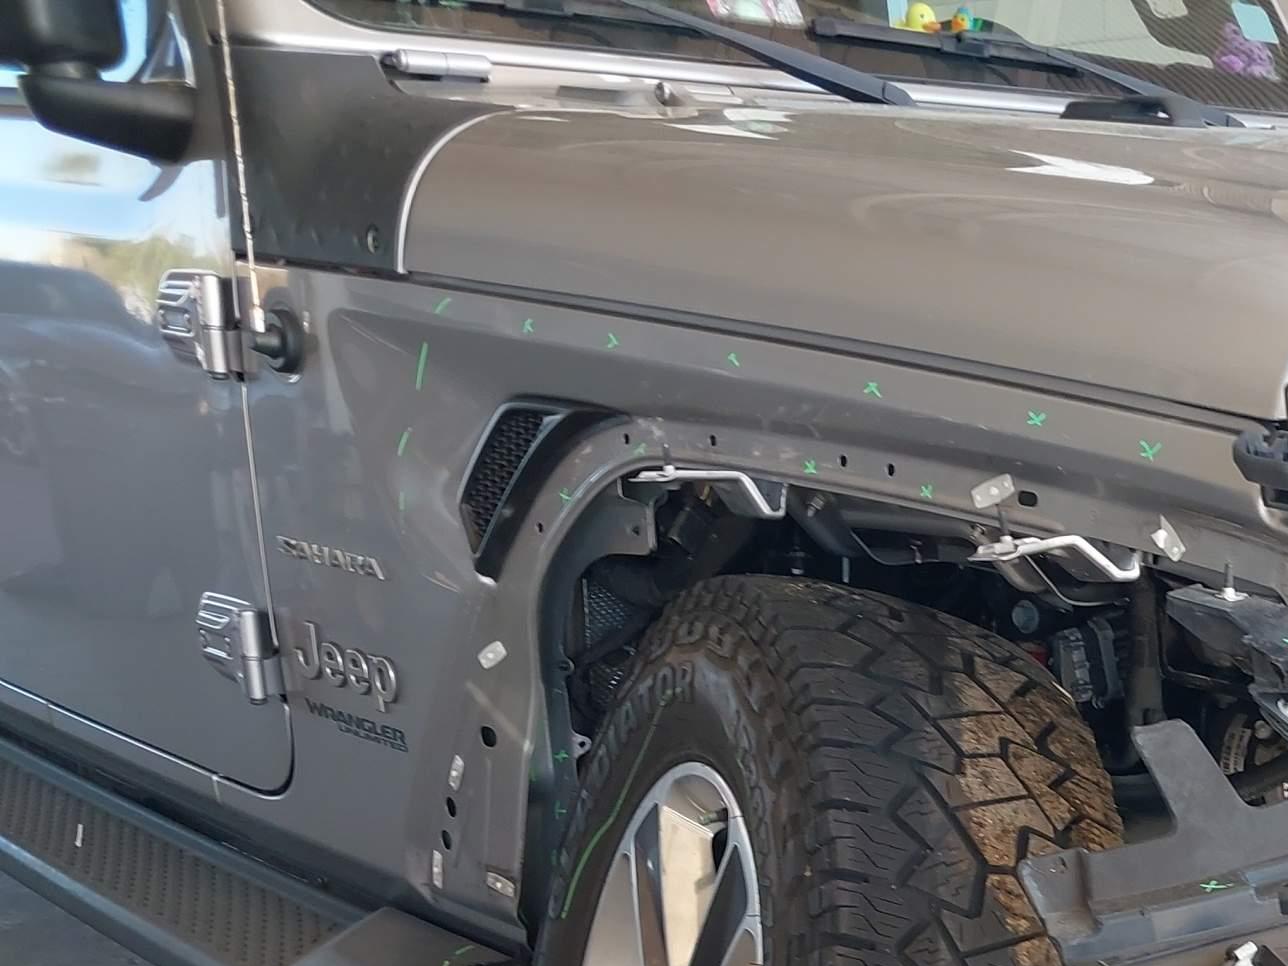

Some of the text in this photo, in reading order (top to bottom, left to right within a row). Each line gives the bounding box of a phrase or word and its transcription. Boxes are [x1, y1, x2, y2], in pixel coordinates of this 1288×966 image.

[276, 534, 386, 581] SAHARA
[293, 618, 399, 714] Jeep
[304, 695, 407, 746] WRANGLER
[337, 721, 410, 753] UNLIMITED
